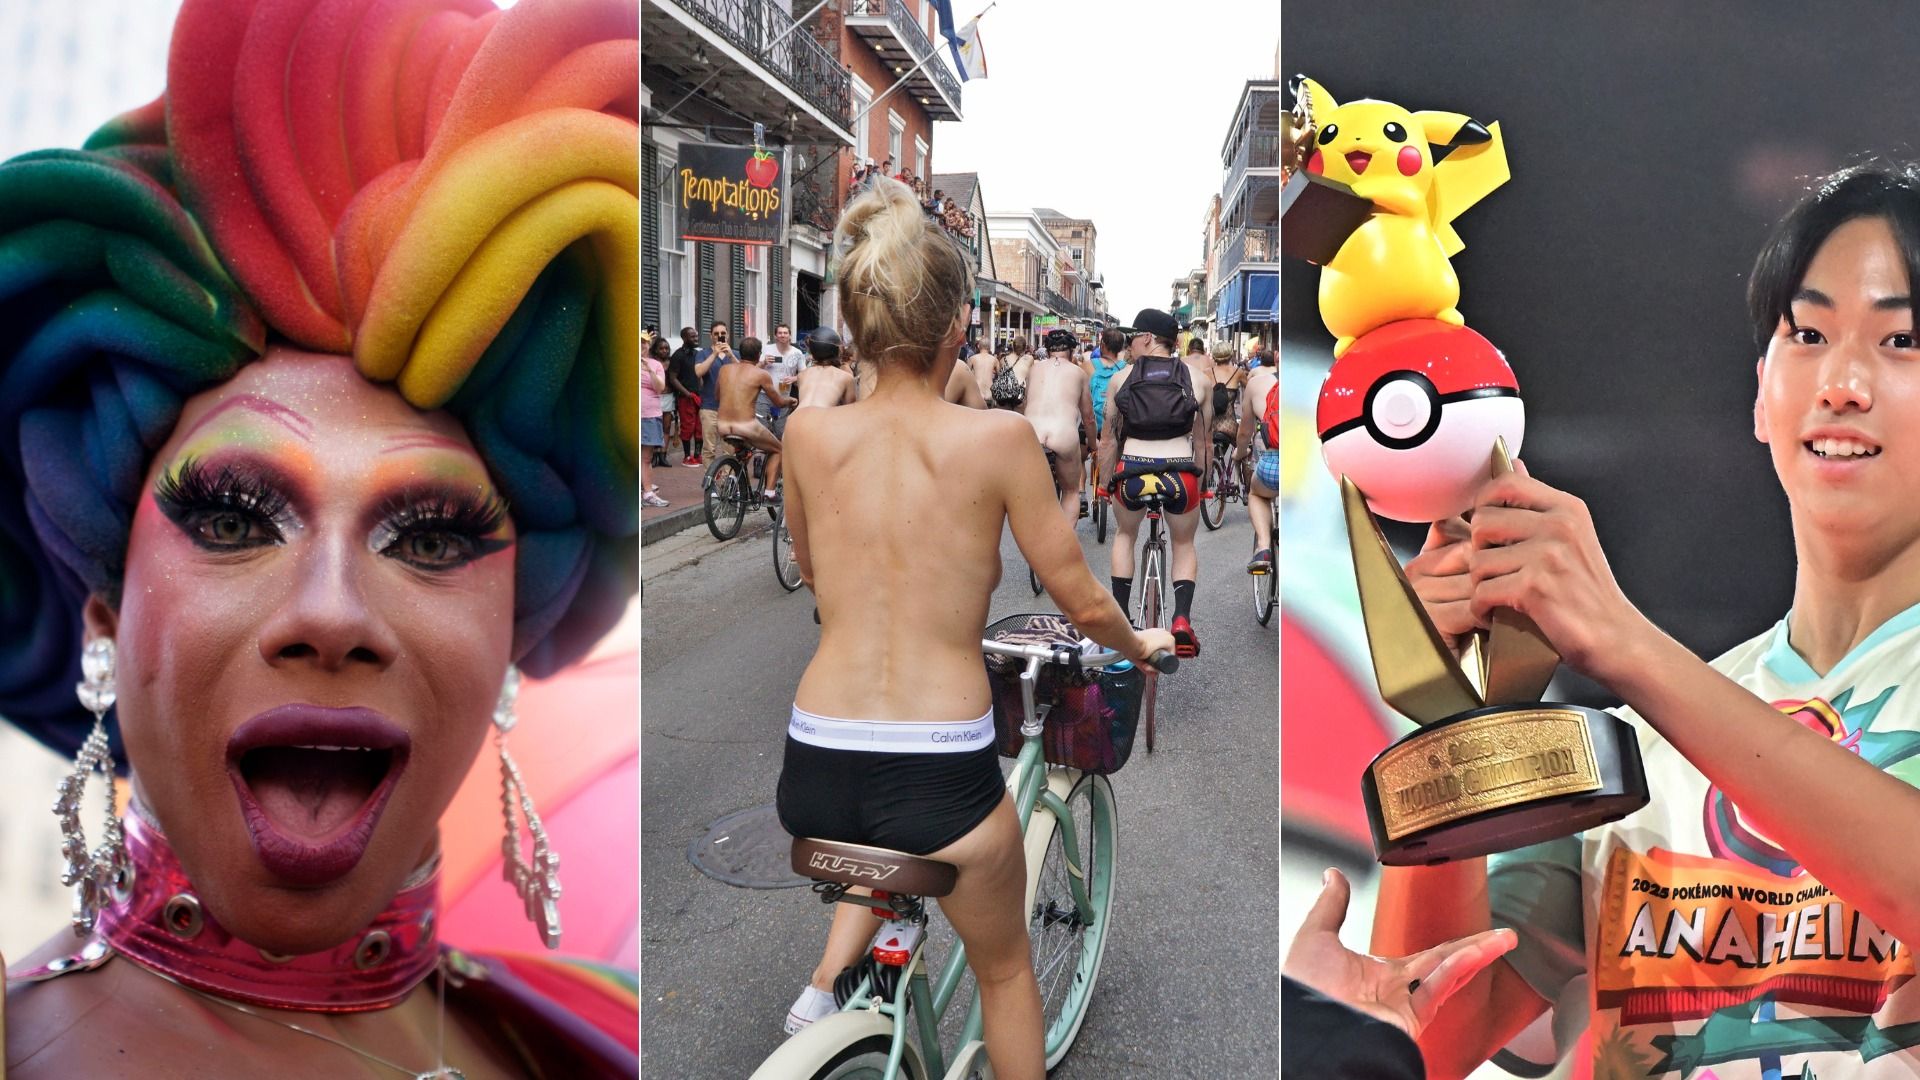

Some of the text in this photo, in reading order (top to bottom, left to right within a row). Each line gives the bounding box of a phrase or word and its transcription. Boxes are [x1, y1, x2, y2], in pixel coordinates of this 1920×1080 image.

[681, 168, 779, 219] Temptations
[931, 730, 983, 743] Calvin Klein
[1449, 735, 1495, 766] 2025
[1397, 748, 1578, 816] WORLD CHAMPION
[809, 851, 900, 880] HUFFY
[1632, 878, 1833, 905] 2025 POKÉMON WORLD CHAMP
[1619, 901, 1902, 968] ANAHEIM
